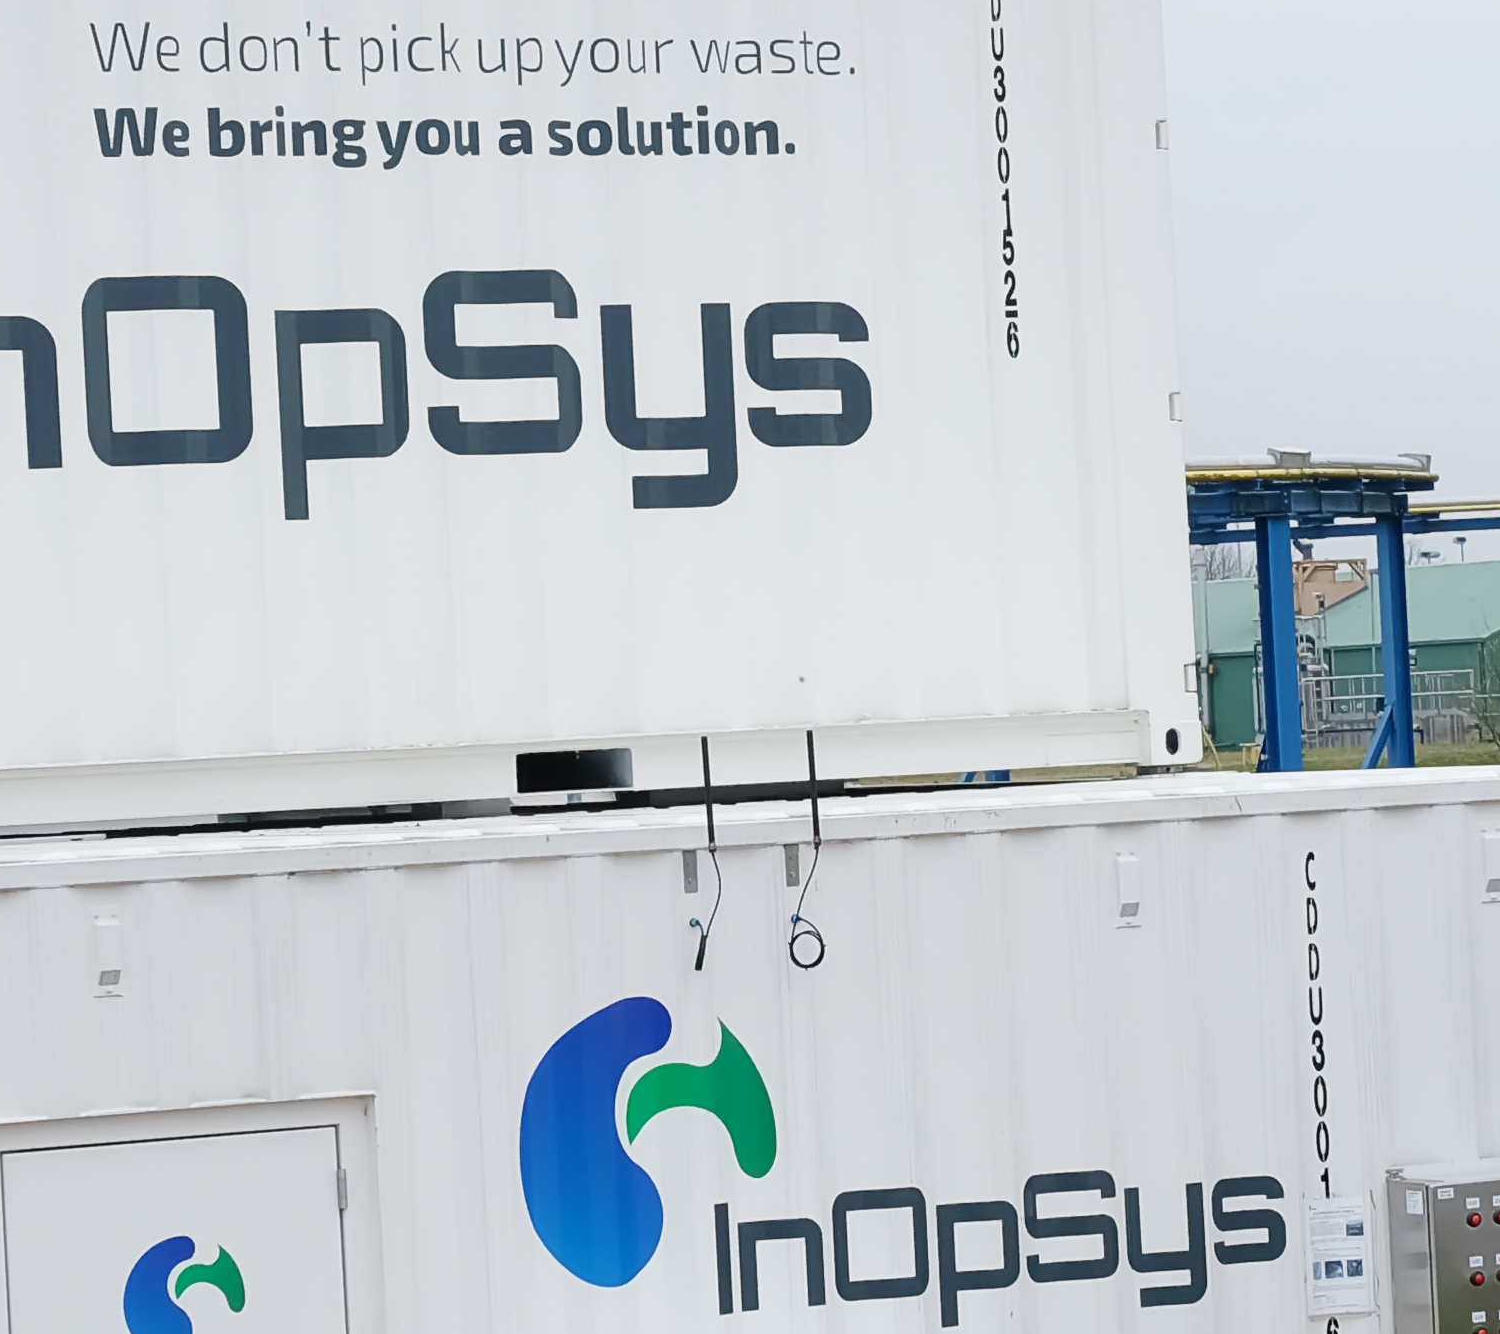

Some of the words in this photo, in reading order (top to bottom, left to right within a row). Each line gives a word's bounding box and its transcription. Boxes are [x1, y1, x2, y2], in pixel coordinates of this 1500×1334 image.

[90, 21, 181, 73] We
[199, 20, 342, 74] don't
[359, 21, 462, 87] pick
[477, 37, 544, 87] up
[554, 38, 676, 88] your
[689, 30, 856, 76] waste.
[92, 106, 190, 158] We
[206, 105, 368, 169] bring
[375, 119, 481, 171] you
[498, 118, 534, 157] a
[547, 104, 796, 157] solution.
[713, 1169, 1287, 1329] InOpSys
